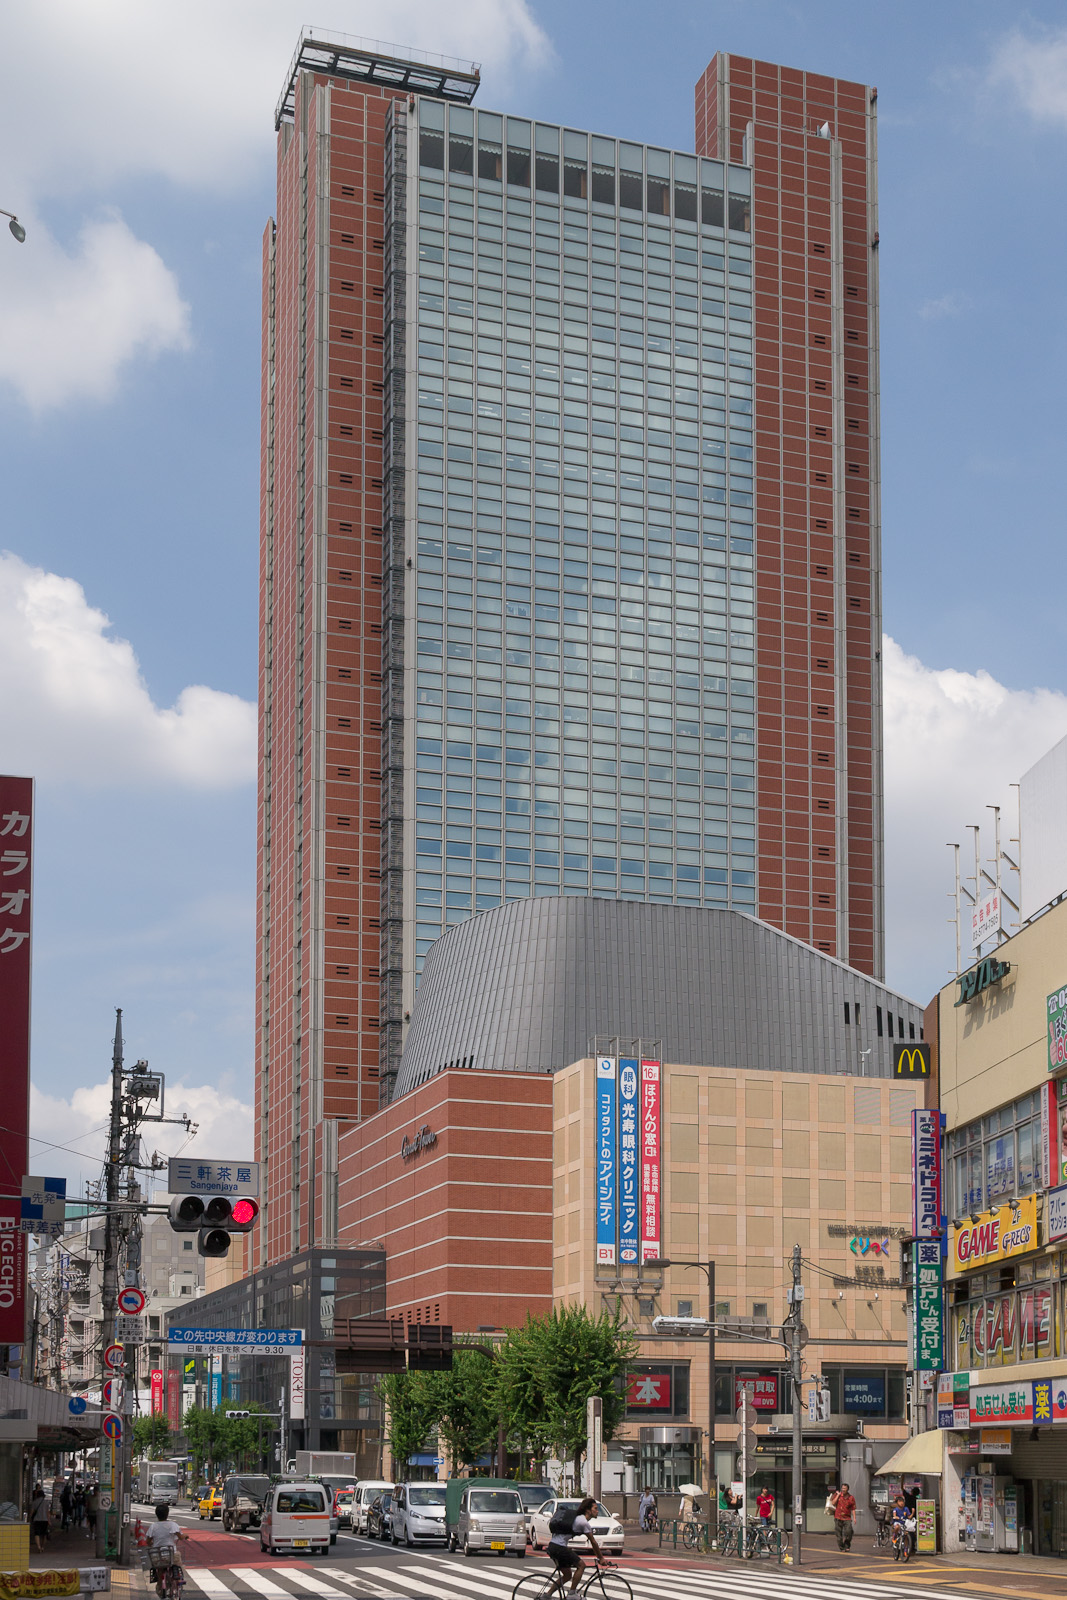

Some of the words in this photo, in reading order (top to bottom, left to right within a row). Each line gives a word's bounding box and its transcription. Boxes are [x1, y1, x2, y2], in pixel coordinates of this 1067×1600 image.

[0, 810, 31, 954] カラオケ
[623, 1071, 634, 1096] 眼科
[644, 1083, 657, 1157] ほけんの窓口
[600, 1094, 613, 1225] コンタクトのアイシティ
[621, 1102, 636, 1234] 光寿眼科クリニック
[177, 1165, 252, 1183] 三軒茶屋
[190, 1180, 239, 1192] Sangenjaya
[32, 1192, 56, 1205] 先発
[22, 1219, 63, 1234] 時差式
[645, 1193, 656, 1238] 無料相談
[599, 1248, 613, 1259] B1
[623, 1249, 634, 1259] 2F
[849, 1237, 889, 1255] くりっく
[920, 1244, 939, 1263] 薬
[957, 1219, 1000, 1263] GAME
[0, 1254, 15, 1308] ECHO
[919, 1267, 940, 1368] 処方せん受付ます
[973, 1296, 1051, 1357] GAME
[173, 1329, 298, 1344] この先中央線が変わります
[292, 1358, 304, 1405] TOKYU
[636, 1376, 662, 1404] 本
[761, 1397, 775, 1406] DVD
[975, 1389, 1027, 1417] 処方せん受付
[1034, 1383, 1051, 1420] 薬
